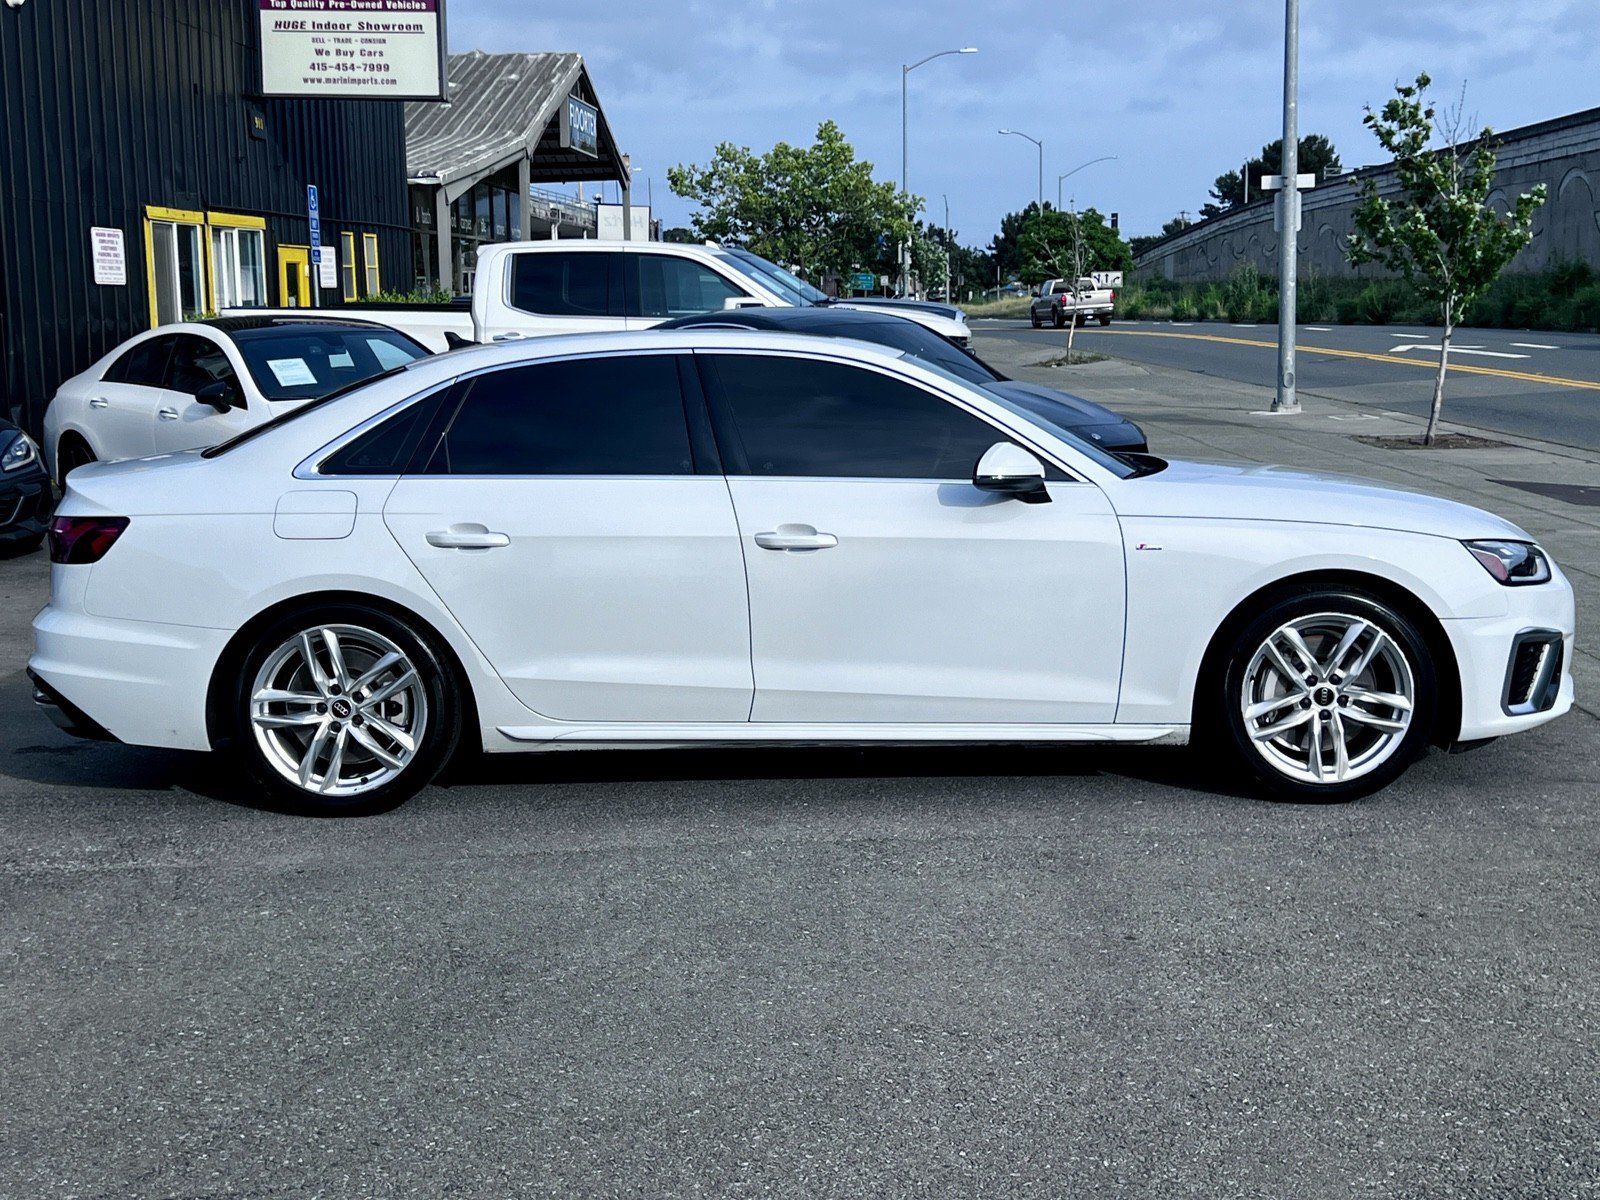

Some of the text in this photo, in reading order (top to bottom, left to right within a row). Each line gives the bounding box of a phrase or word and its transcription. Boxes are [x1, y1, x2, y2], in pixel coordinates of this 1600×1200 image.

[270, 0, 427, 10] Top Quality Pre-Owned Vehicles
[274, 20, 423, 31] HUGE Indoor Showroom
[314, 48, 384, 58] We Buy Cars
[309, 62, 390, 72] 415-454-7999
[302, 77, 397, 86] www.marinimports.com
